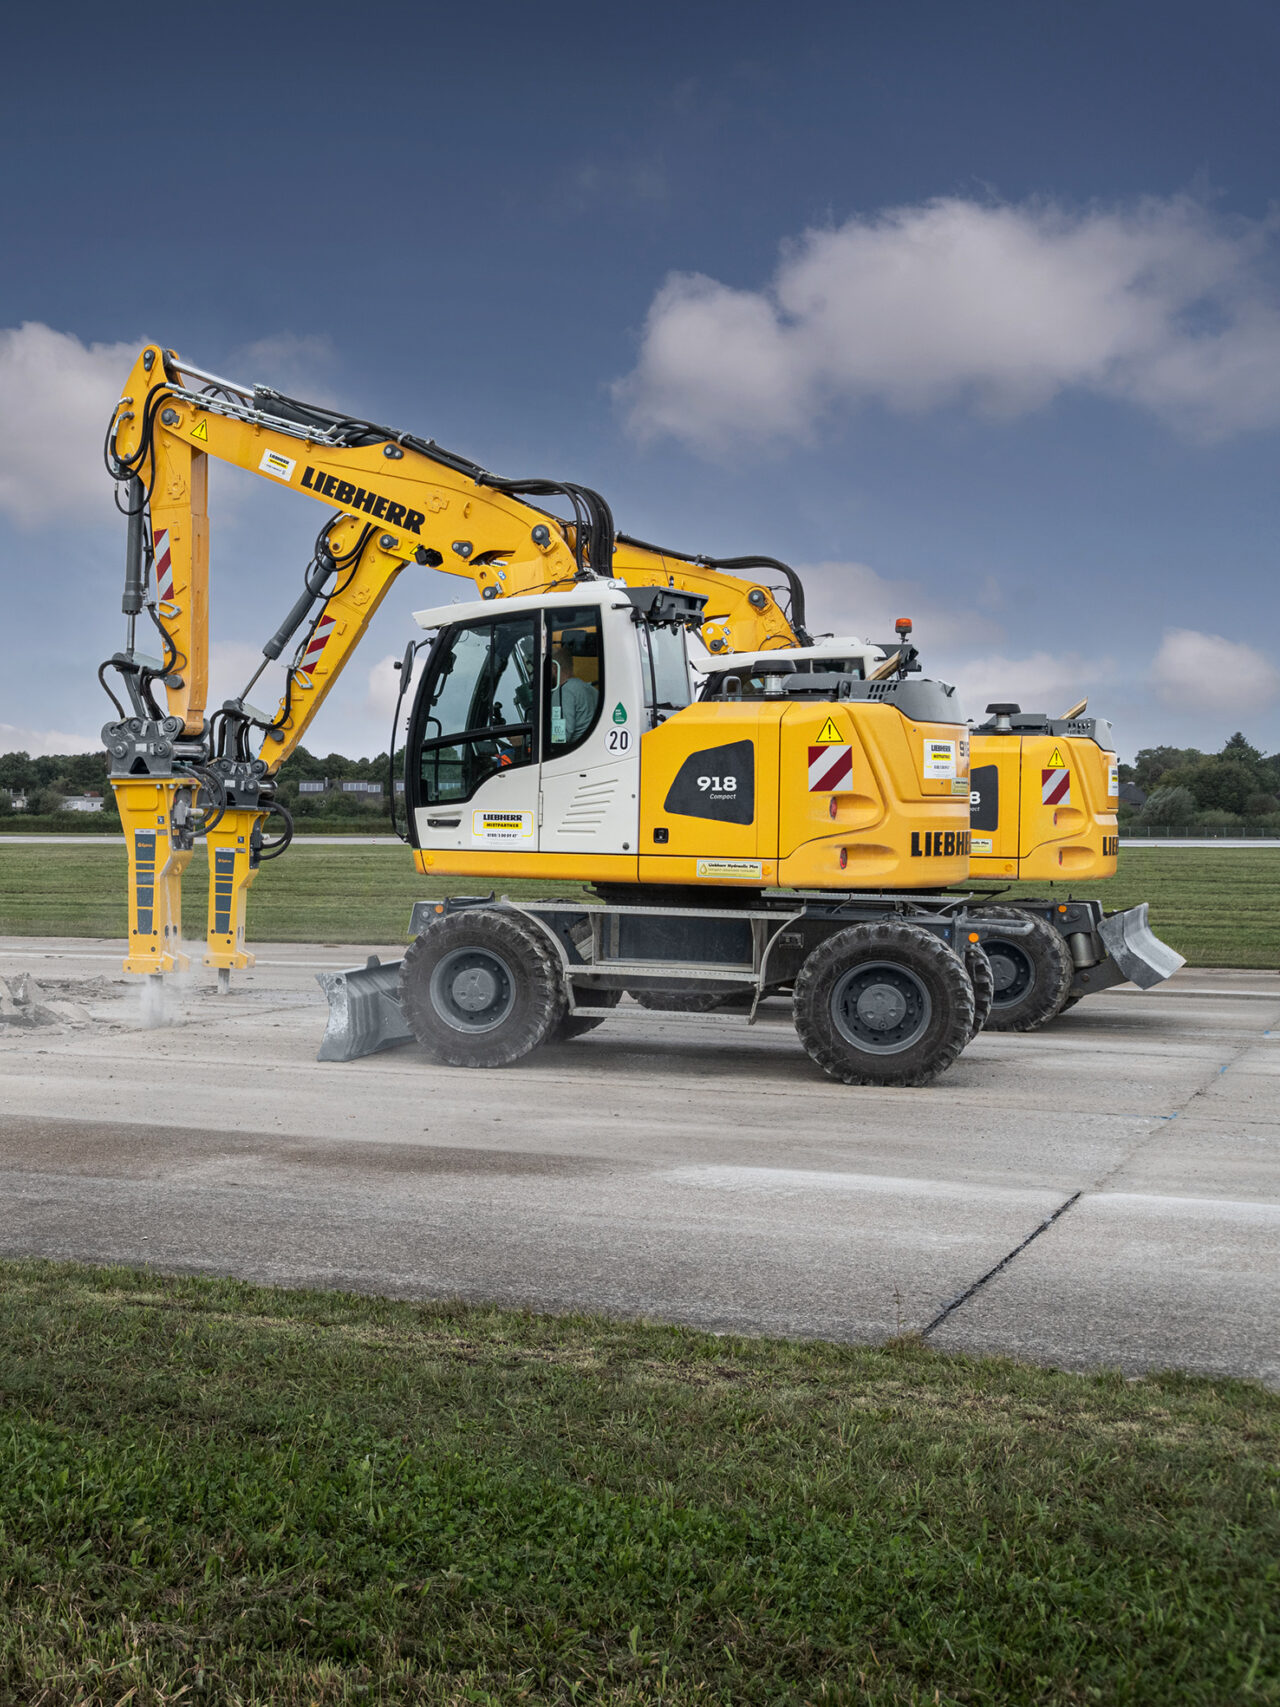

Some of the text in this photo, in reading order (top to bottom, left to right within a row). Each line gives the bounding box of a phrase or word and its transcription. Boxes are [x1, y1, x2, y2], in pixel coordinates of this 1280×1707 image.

[300, 465, 426, 536] LIEBHERR
[609, 730, 628, 750] 20
[696, 776, 737, 791] 918
